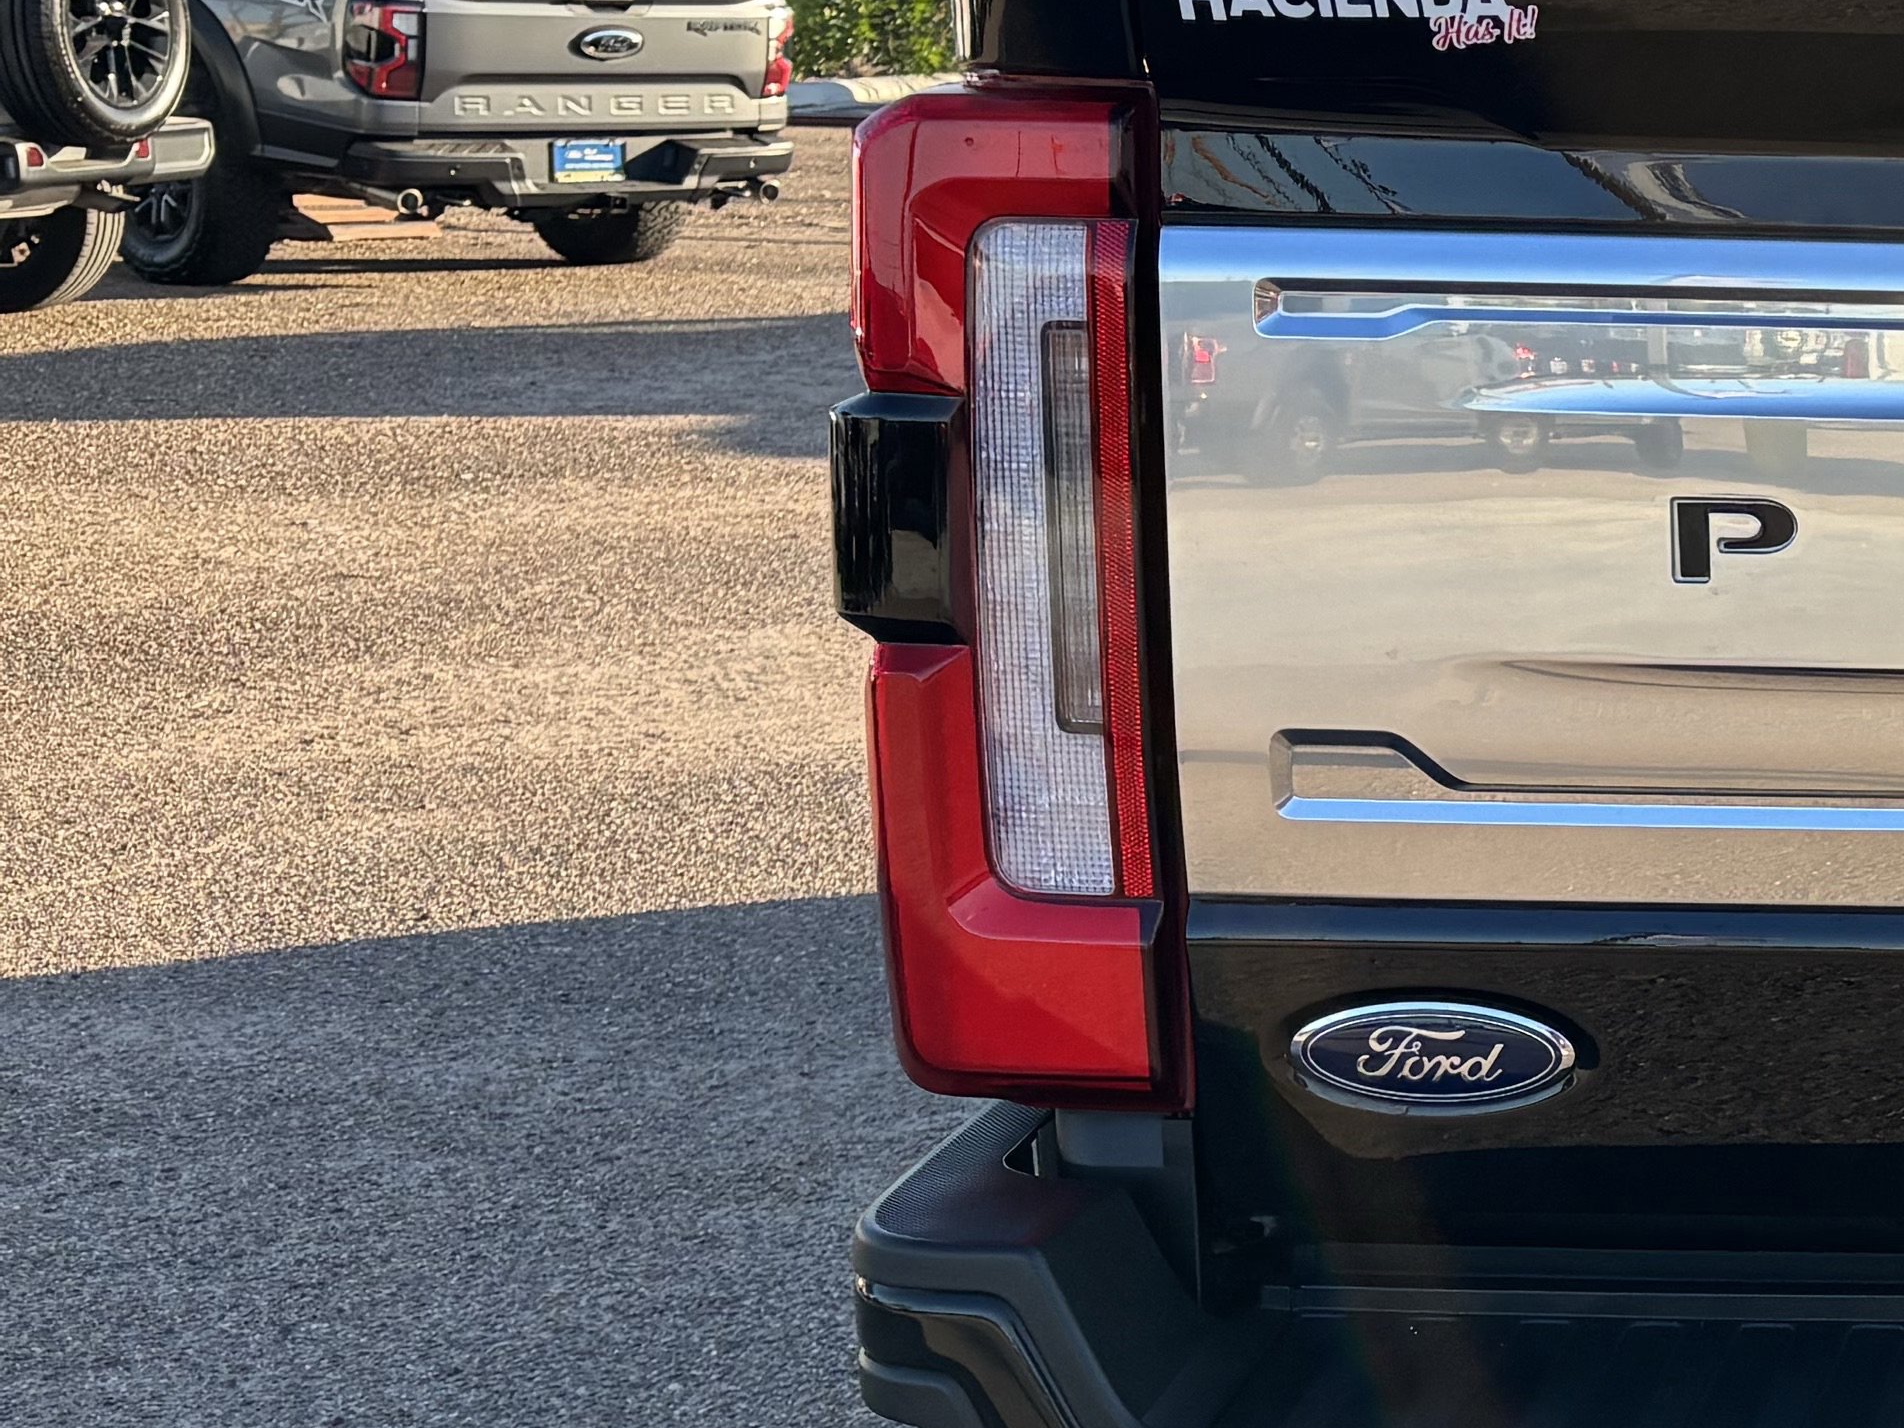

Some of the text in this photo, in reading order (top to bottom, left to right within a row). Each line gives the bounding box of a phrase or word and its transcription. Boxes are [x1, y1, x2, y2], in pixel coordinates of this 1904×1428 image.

[1429, 12, 1500, 51] Has
[453, 93, 735, 117] RANGER
[1356, 1025, 1505, 1082] Ford
